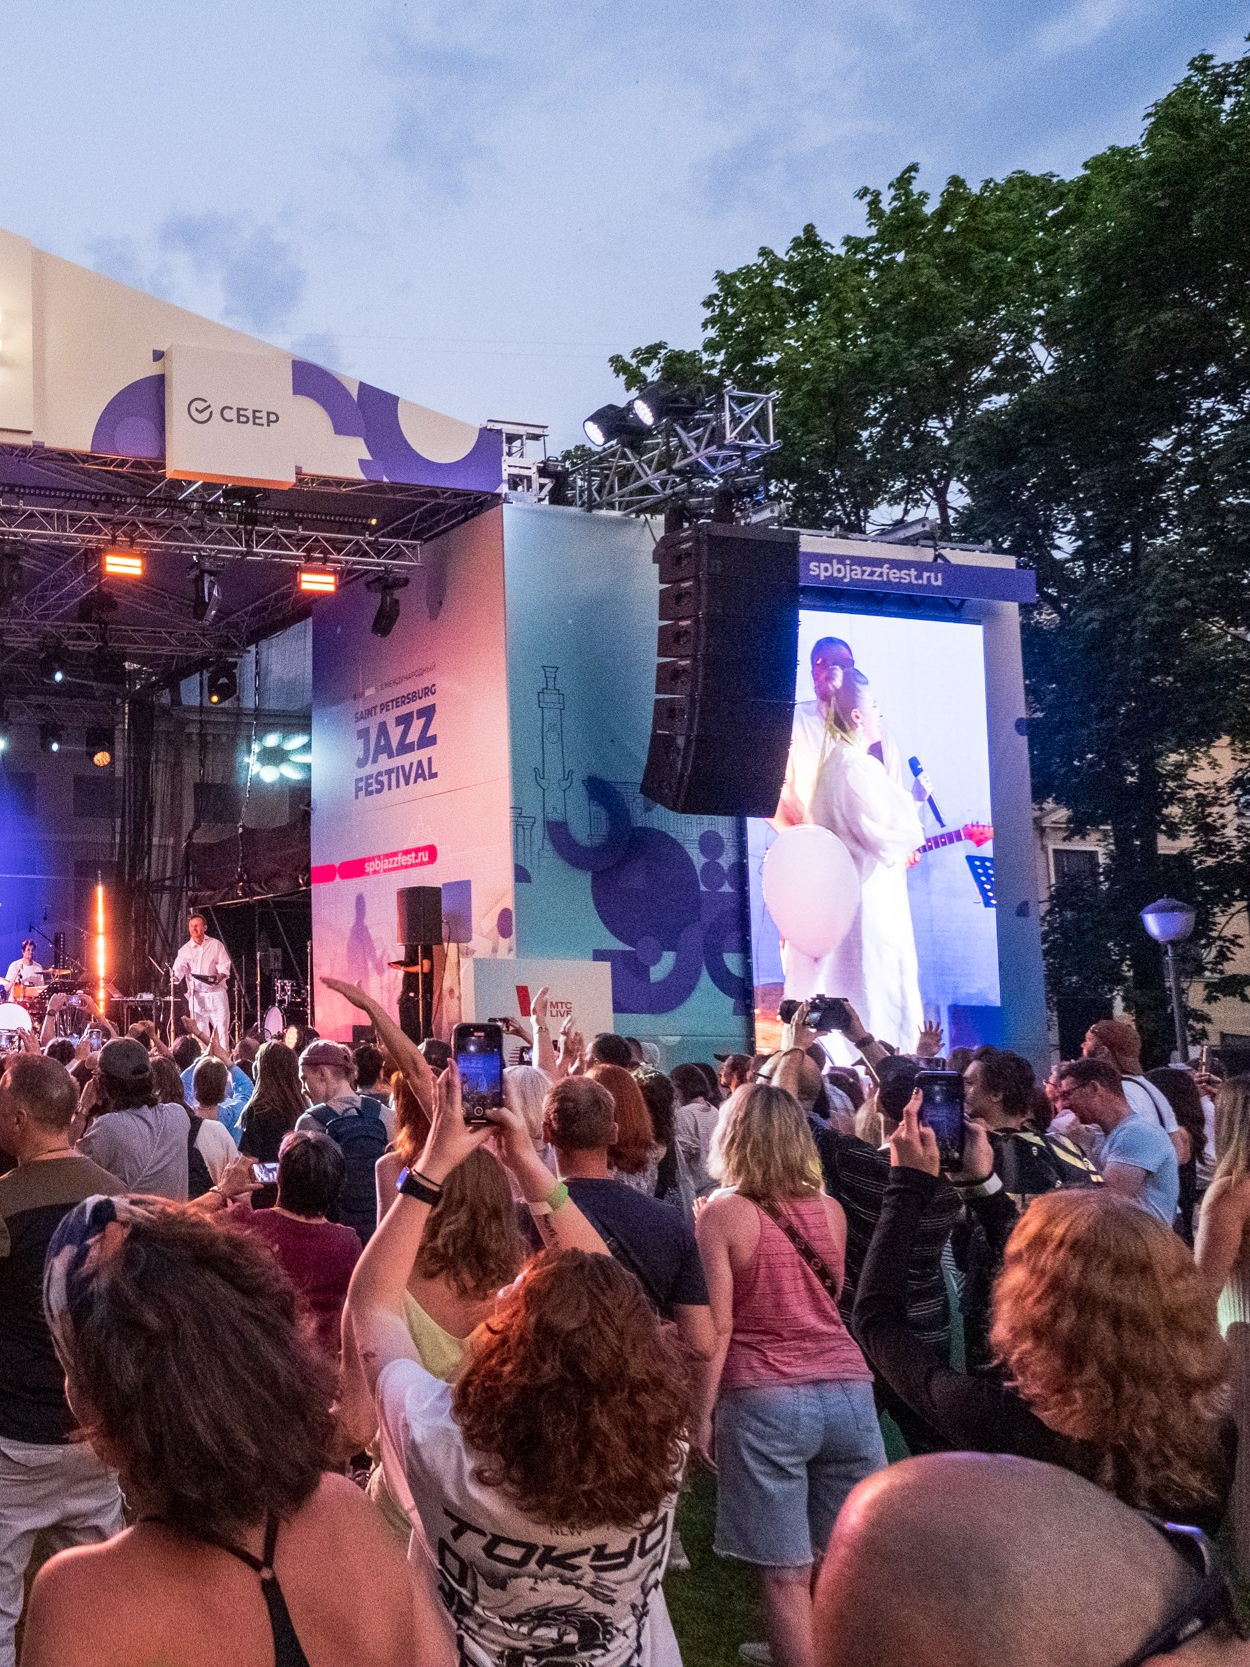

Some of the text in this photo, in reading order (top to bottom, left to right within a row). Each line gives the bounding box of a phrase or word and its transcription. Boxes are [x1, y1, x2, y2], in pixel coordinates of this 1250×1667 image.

[220, 405, 280, 427] СБЕР
[809, 560, 943, 586] spbjazzfest.ru
[354, 683, 437, 723] SAINT PETERSBURG
[355, 703, 437, 769] JAZZ
[354, 757, 438, 800] FESTIVAL
[364, 851, 429, 875] spbjazzfest.ru
[443, 1505, 669, 1571] TOKYO
